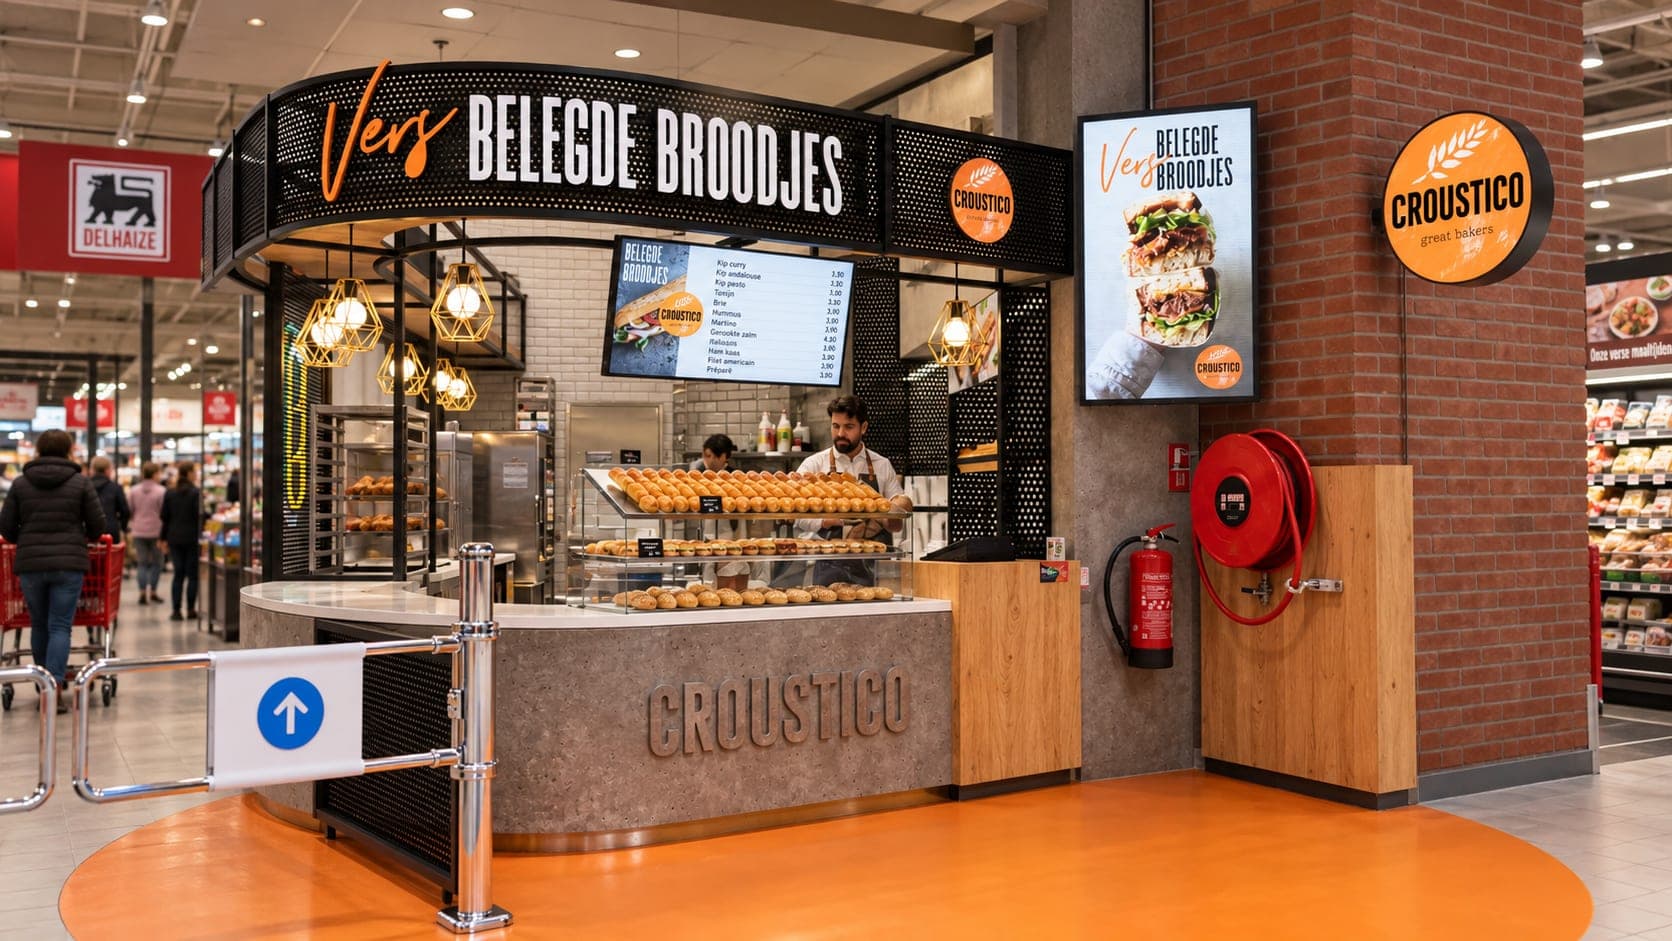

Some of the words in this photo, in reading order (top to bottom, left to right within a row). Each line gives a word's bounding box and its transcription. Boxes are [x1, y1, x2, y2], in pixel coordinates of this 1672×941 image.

[321, 58, 459, 202] Vers
[469, 94, 637, 190] BELEGDE
[657, 108, 843, 216] BROODJES
[1156, 125, 1219, 159] BELEGDE
[1100, 127, 1172, 193] Vers
[1156, 157, 1233, 191] BROODJES
[954, 189, 1011, 214] CROUSTICO
[1392, 172, 1524, 230] CROUSTICO
[83, 228, 157, 250] DELHAIZE
[1420, 231, 1452, 248] great
[1454, 225, 1494, 240] bakers
[625, 243, 663, 264] BELEGDE
[717, 260, 728, 268] Kip
[729, 261, 746, 270] curry
[727, 281, 746, 289] pesto
[661, 309, 701, 322] CROUSTICO
[710, 328, 740, 337] Gerookte
[1591, 348, 1608, 362] Onze
[1609, 348, 1630, 361] verse
[1197, 362, 1240, 374] CROUSTICO
[649, 666, 911, 758] CROUSTICO
